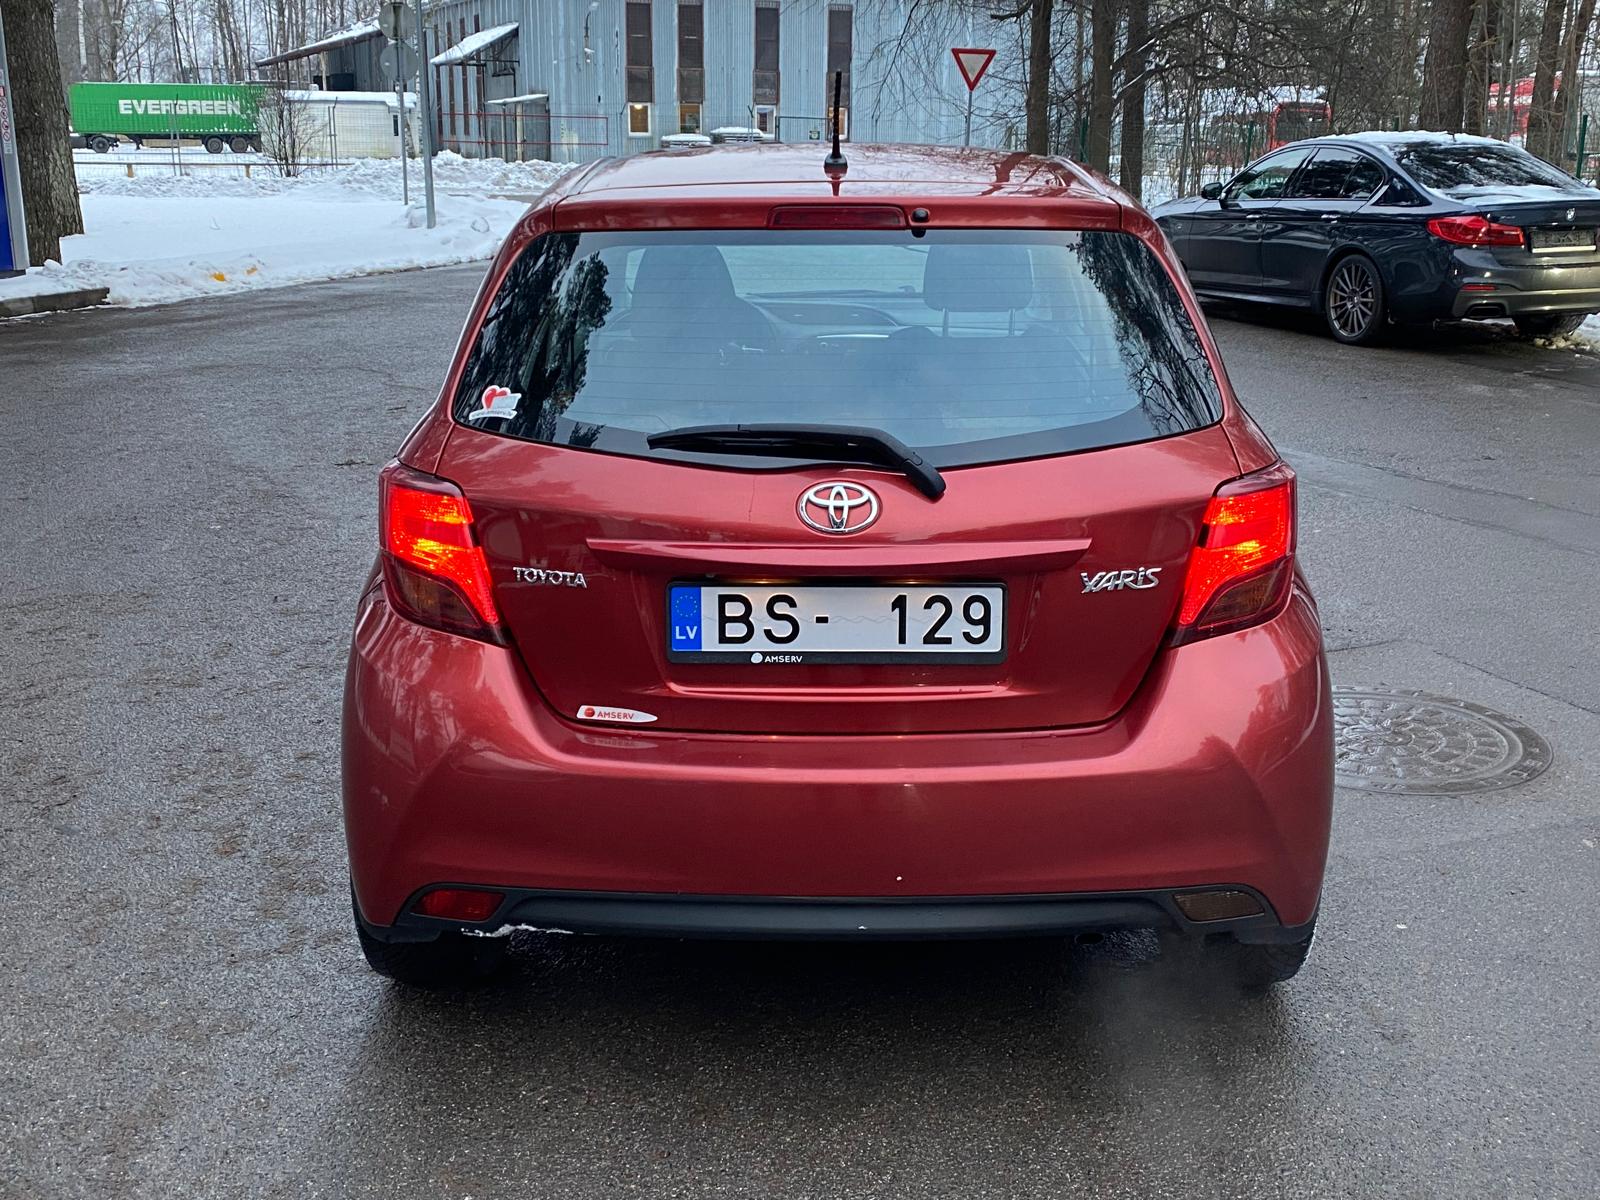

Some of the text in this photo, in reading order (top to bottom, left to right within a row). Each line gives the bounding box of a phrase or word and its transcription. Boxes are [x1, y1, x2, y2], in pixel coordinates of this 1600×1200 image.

[118, 99, 241, 115] EVERGREEN
[512, 566, 587, 589] TOYOTA
[891, 593, 992, 645] 129
[675, 625, 698, 640] LV
[764, 655, 803, 663] AMSERV
[597, 711, 634, 720] AMSERV
